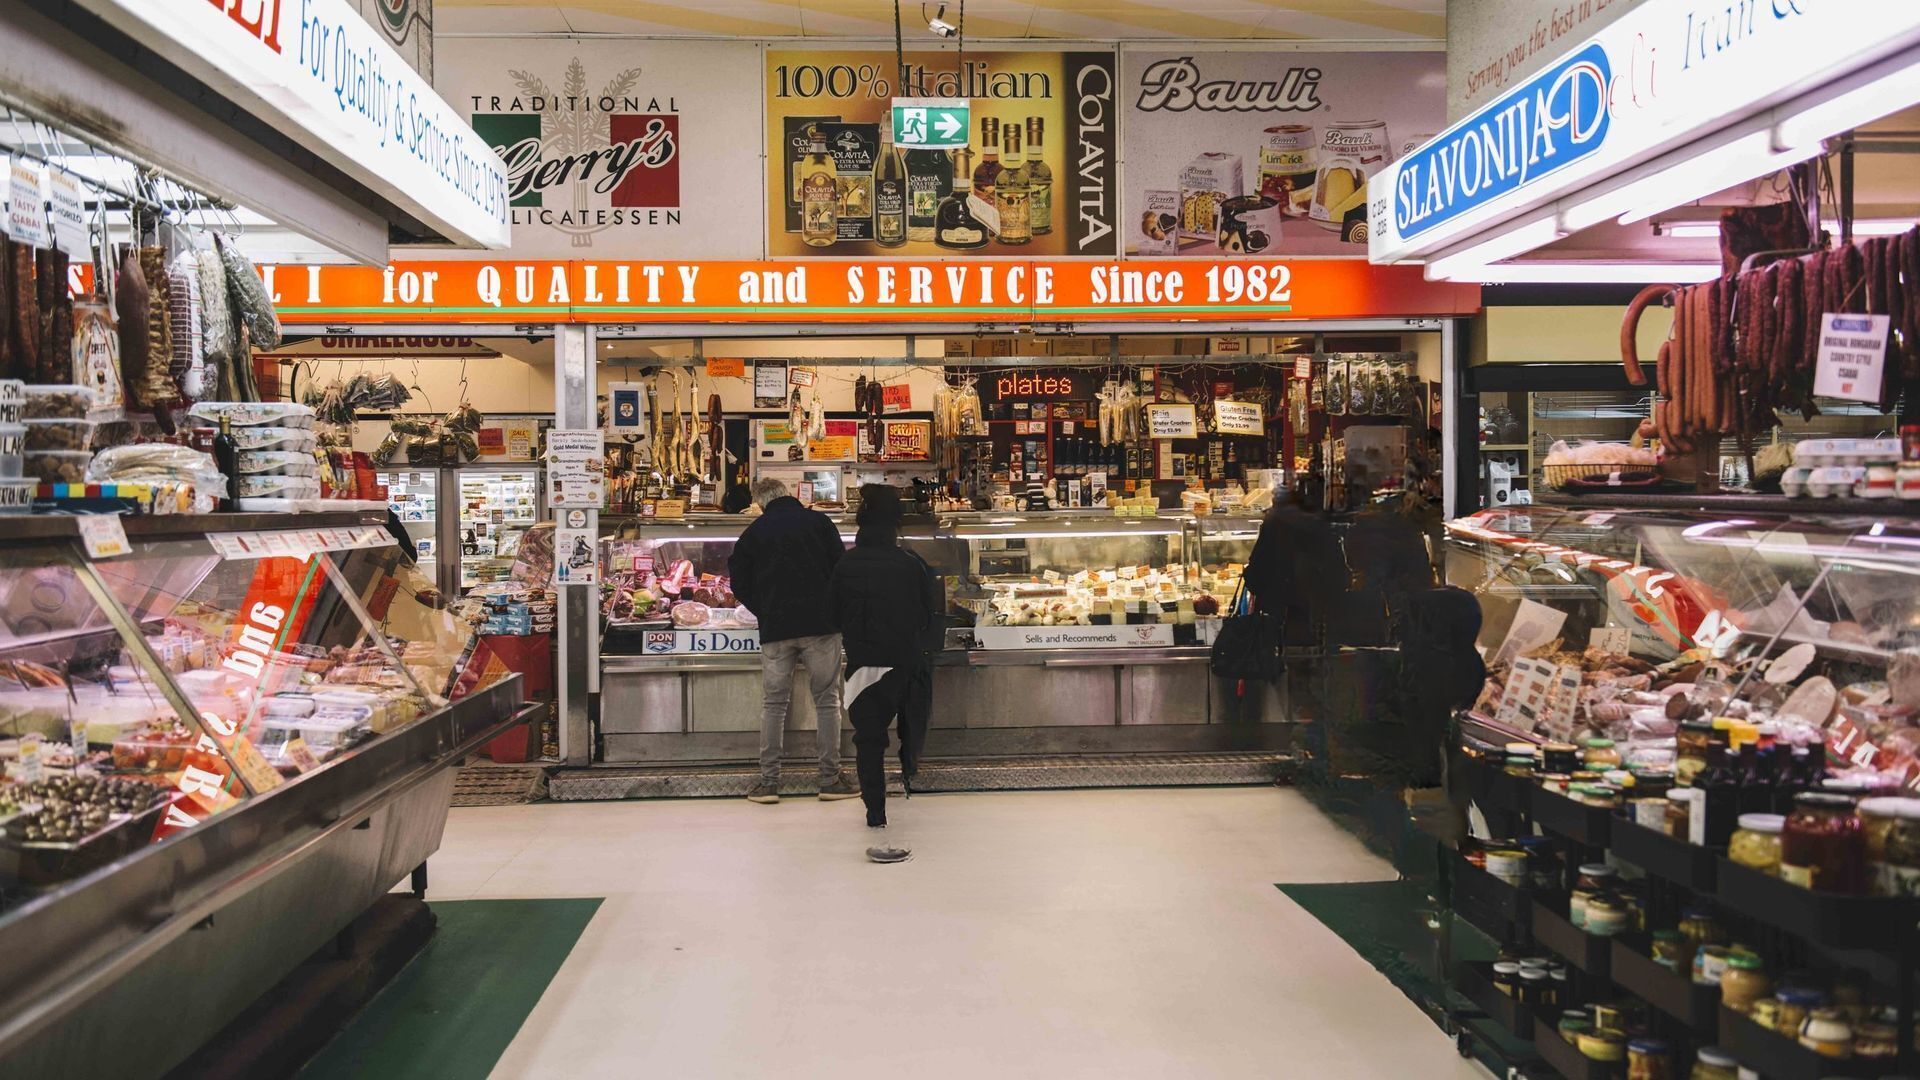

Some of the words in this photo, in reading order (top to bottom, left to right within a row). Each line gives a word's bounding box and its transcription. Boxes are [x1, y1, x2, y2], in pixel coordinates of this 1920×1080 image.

[1465, 57, 1503, 99] Serving
[1504, 42, 1525, 82] you
[1528, 19, 1547, 56] the
[1550, 8, 1575, 42] best
[774, 63, 889, 98] 100%
[901, 62, 1052, 99] Italian
[1136, 56, 1323, 113] Bauli
[299, 0, 330, 83] For
[334, 25, 391, 148] Quality
[394, 80, 405, 145] &
[409, 93, 451, 183] Service
[454, 134, 481, 206] Since
[472, 96, 679, 113] TRADITIONAL
[1325, 130, 1372, 146] Bauli
[495, 118, 677, 197] Gerry's
[1076, 63, 1113, 251] COLAVITA
[1398, 88, 1556, 229] SLAVONIJA
[512, 209, 681, 225] LICATESSEN
[382, 265, 438, 304] for
[477, 265, 700, 307] QUALITY
[738, 266, 807, 304] and
[847, 265, 1054, 304] SERVICE
[1090, 265, 1184, 304] Since
[1205, 264, 1291, 303] 1982
[997, 372, 1072, 400] plates
[1220, 405, 1241, 413] Gluten
[1242, 406, 1257, 415] Free
[648, 633, 673, 642] DON
[689, 632, 706, 651] Is
[1025, 634, 1042, 643] Sells
[1045, 634, 1060, 643] and
[1062, 633, 1117, 643] Recommends
